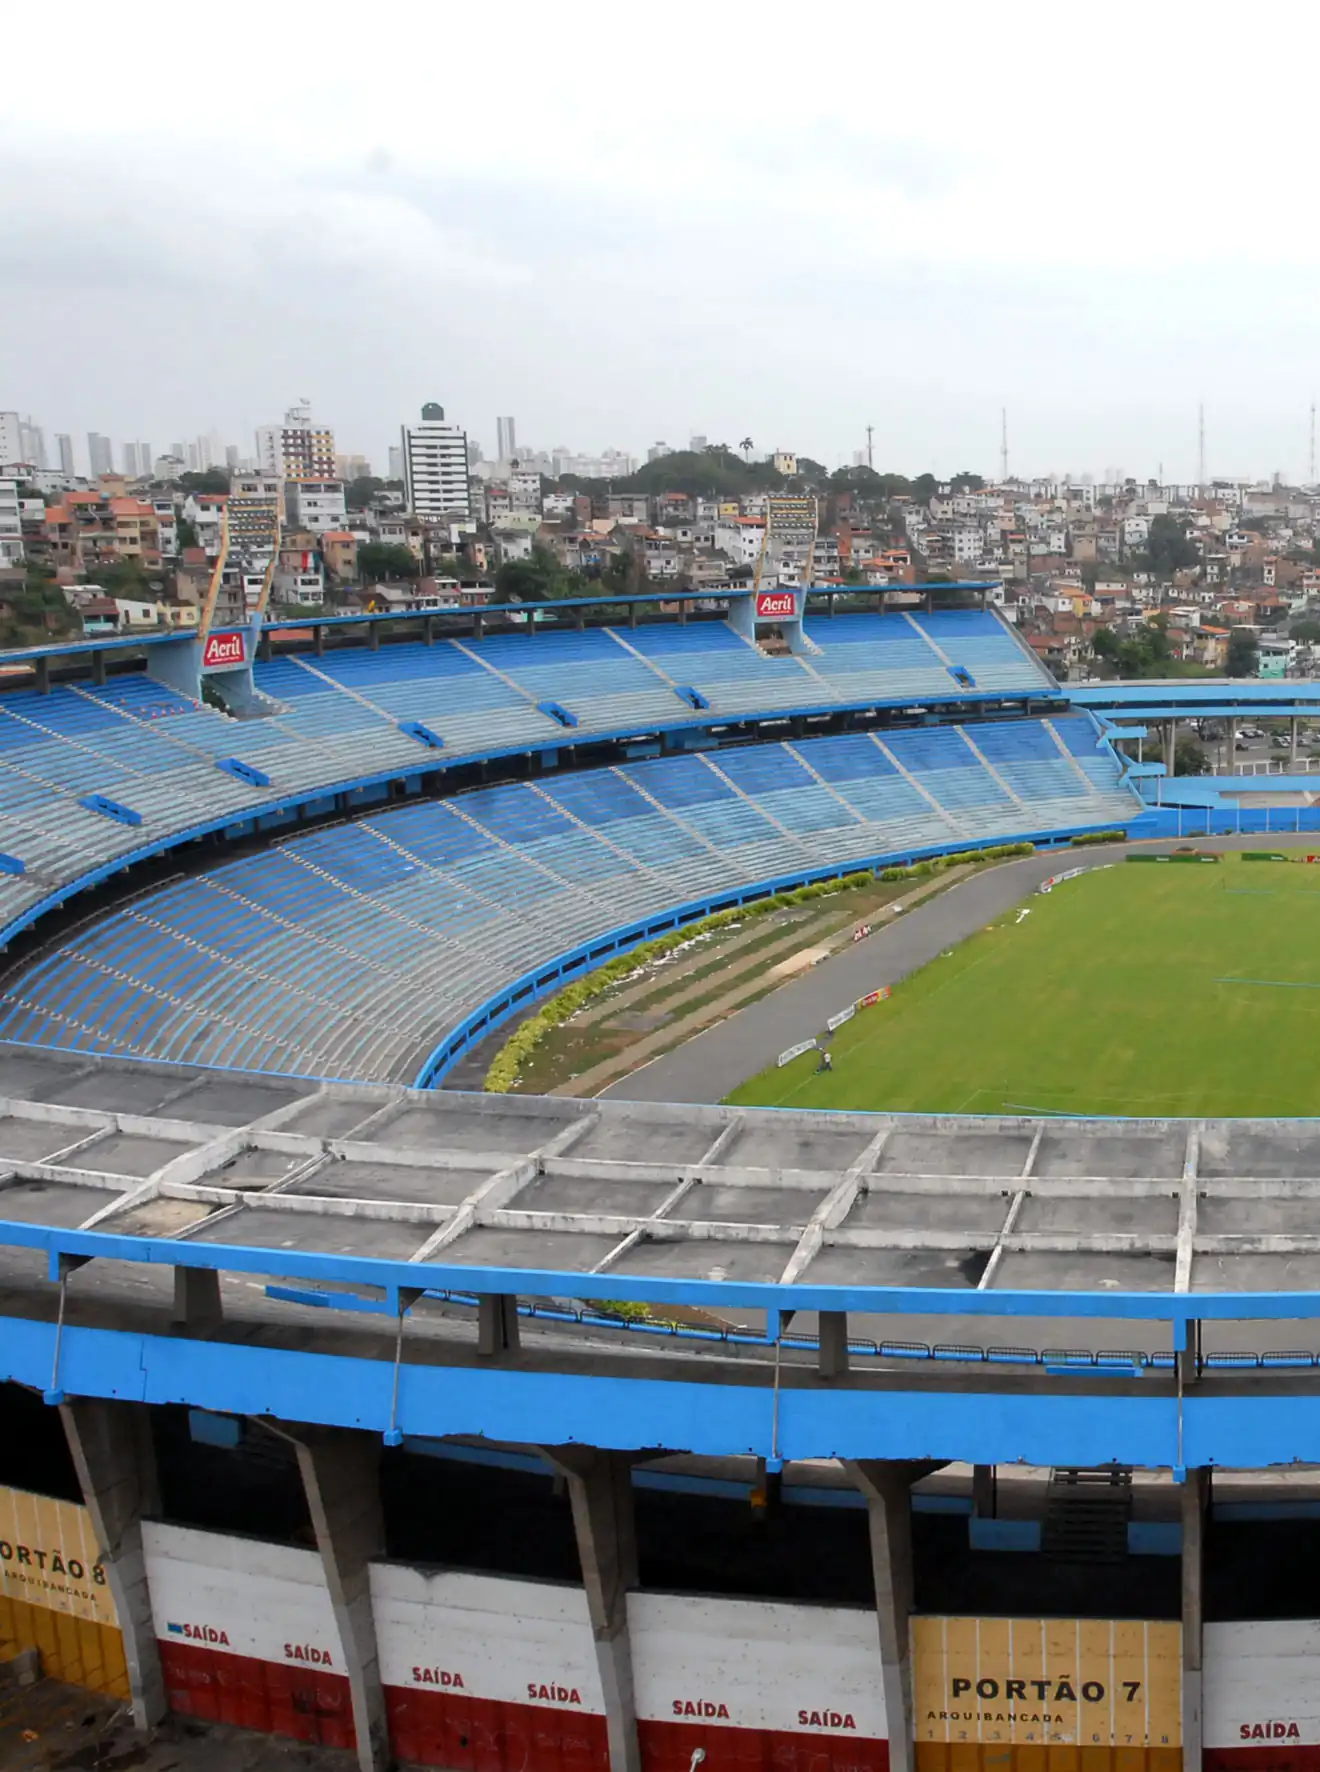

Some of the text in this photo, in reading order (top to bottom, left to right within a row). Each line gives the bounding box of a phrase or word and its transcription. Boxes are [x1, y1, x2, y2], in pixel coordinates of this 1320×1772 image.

[0, 1541, 106, 1585] ORTÃO 8
[183, 1623, 230, 1646] SAÍDA
[284, 1643, 333, 1666] SAÍDA
[412, 1666, 464, 1688] SAÍDA
[527, 1682, 581, 1704] SAÍDA
[952, 1674, 1141, 1703] PORTÃO 7
[672, 1699, 730, 1719] SAÍDA
[798, 1709, 856, 1729] SAÍDA
[927, 1711, 1063, 1723] ARQUIBANCADA
[1240, 1719, 1300, 1740] SAÍDA
